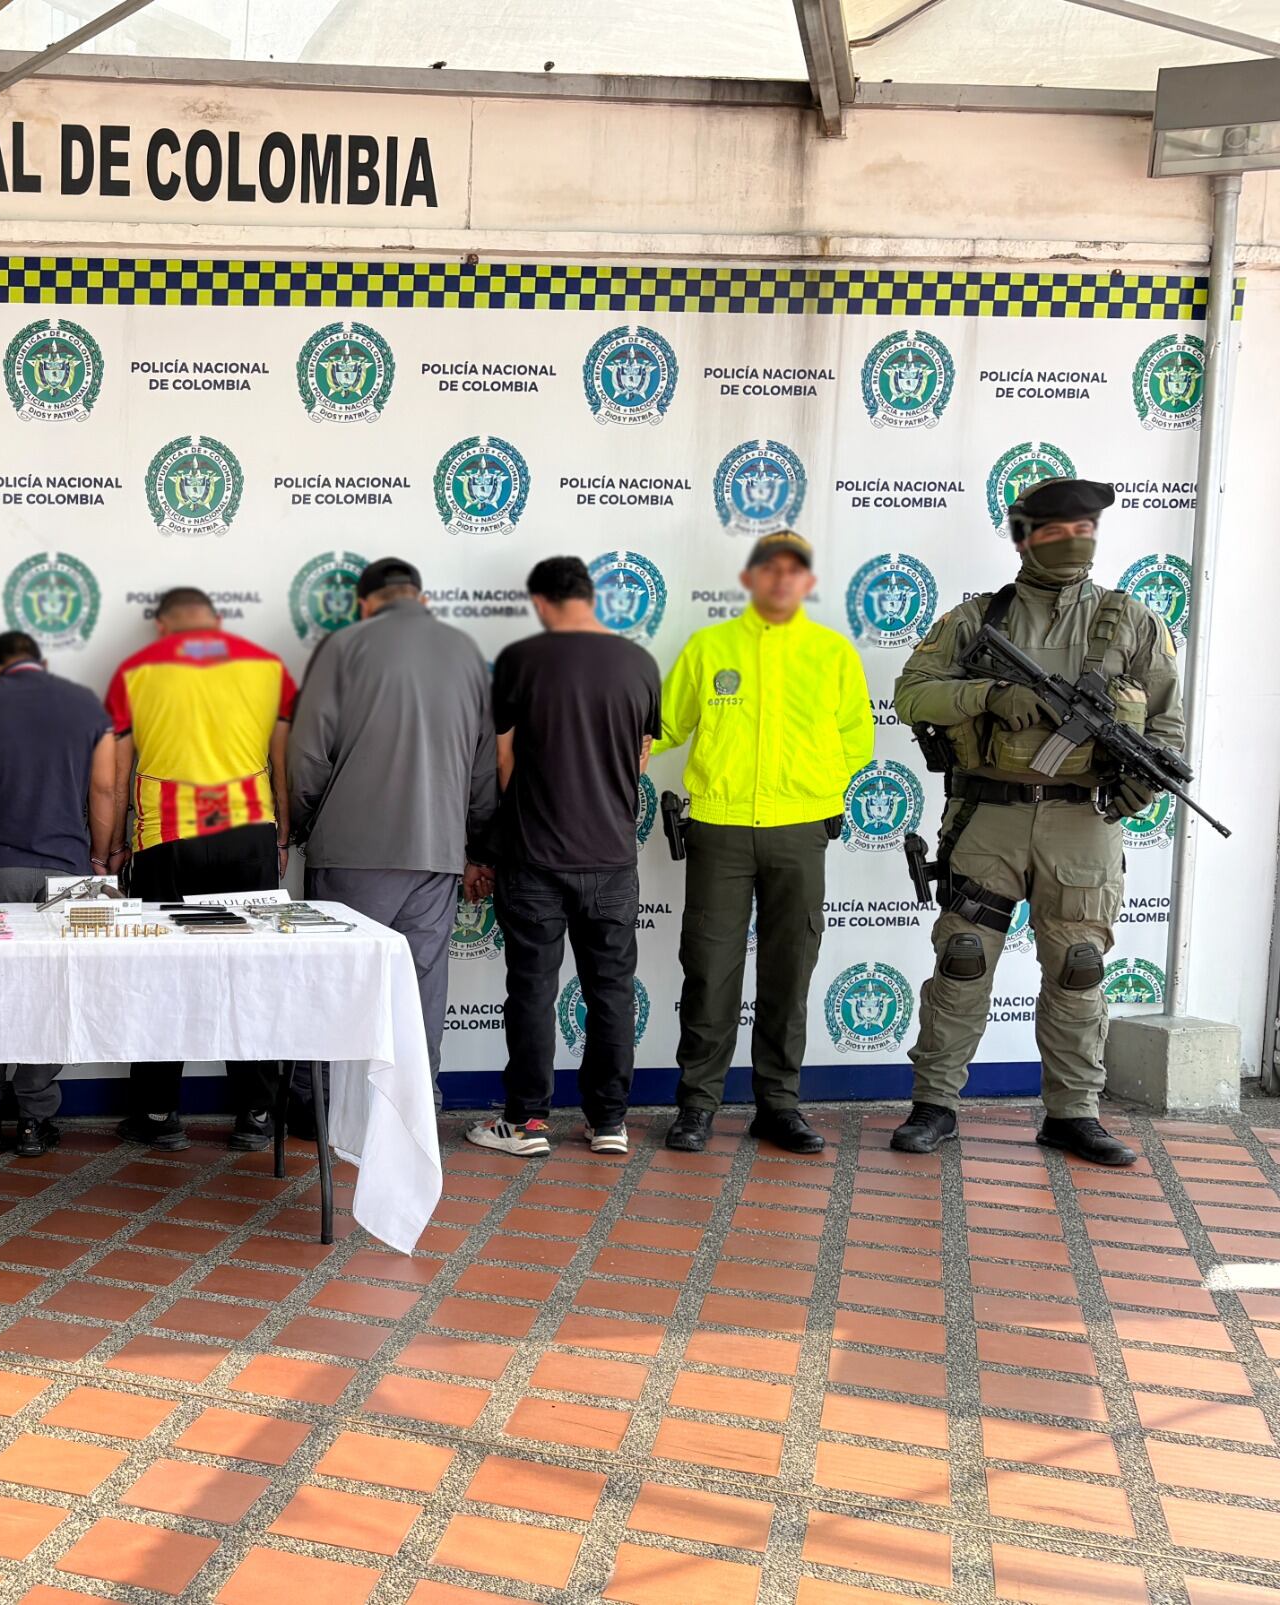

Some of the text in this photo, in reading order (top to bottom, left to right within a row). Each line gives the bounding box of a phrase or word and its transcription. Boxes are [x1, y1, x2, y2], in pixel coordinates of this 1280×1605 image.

[61, 125, 130, 196] DE
[147, 129, 437, 207] COLOMBIA
[131, 359, 269, 374] POLICÍA NACIONAL
[422, 361, 556, 376] POLICÍA NACIONAL
[704, 365, 835, 380] POLICÍA NACIONAL
[980, 368, 1107, 383] POLICÍA NACIONAL
[149, 379, 251, 390] DE COLOMBIA
[439, 380, 539, 392] DE COLOMBIA
[720, 384, 817, 396] DE COLOMBIA
[996, 387, 1090, 399] DE COLOMBIA
[46, 477, 122, 488] NACIONAL
[274, 474, 411, 488] POLICÍA NACIONAL
[560, 475, 691, 490] POLICÍA NACIONAL
[836, 478, 965, 492] POLICÍA NACIONAL
[3, 493, 104, 505] DE COLOMBIA
[292, 493, 392, 505] DE COLOMBIA
[577, 494, 674, 506] DE COLOMBIA
[852, 497, 947, 508] DE COLOMBIA
[1121, 498, 1140, 509] DE
[423, 588, 528, 601] OLICÍA NACION
[822, 899, 937, 912] OLICÍA NACIONAL
[1129, 897, 1170, 908] NACIO
[827, 916, 920, 927] DE COLOMBIA
[1119, 912, 1170, 923] OLOMBI
[993, 996, 1035, 1007] NACIO
[460, 1004, 504, 1015] NACIO
[986, 1012, 1035, 1022] OLOMBI
[443, 1020, 505, 1030] COLOMBI
